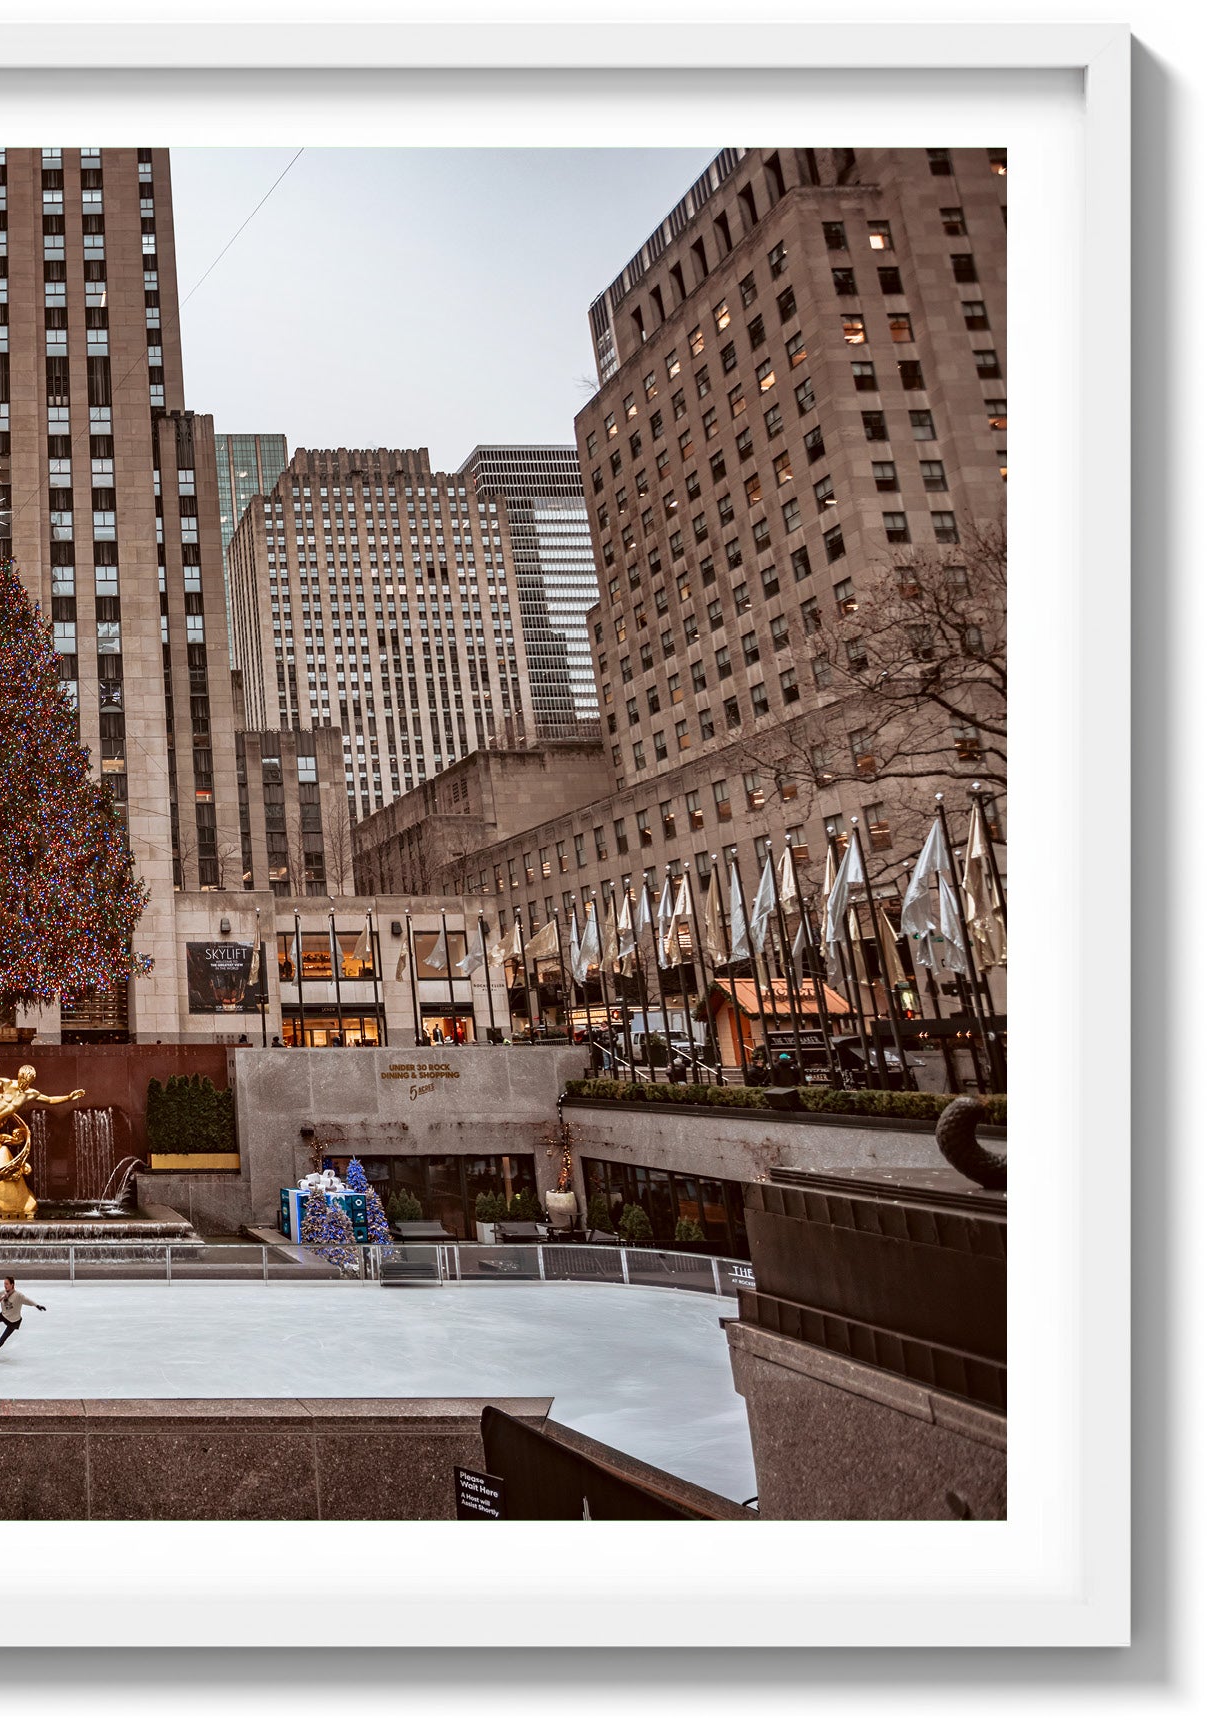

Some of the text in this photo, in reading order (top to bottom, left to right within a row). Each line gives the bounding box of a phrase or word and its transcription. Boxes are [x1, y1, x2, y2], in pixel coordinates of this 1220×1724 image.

[205, 948, 247, 960] SKYLIFT
[410, 1085, 418, 1101] 5
[732, 1265, 753, 1278] THE
[460, 1471, 485, 1485] Please
[460, 1480, 499, 1498] Wait Here
[466, 1493, 480, 1503] Host
